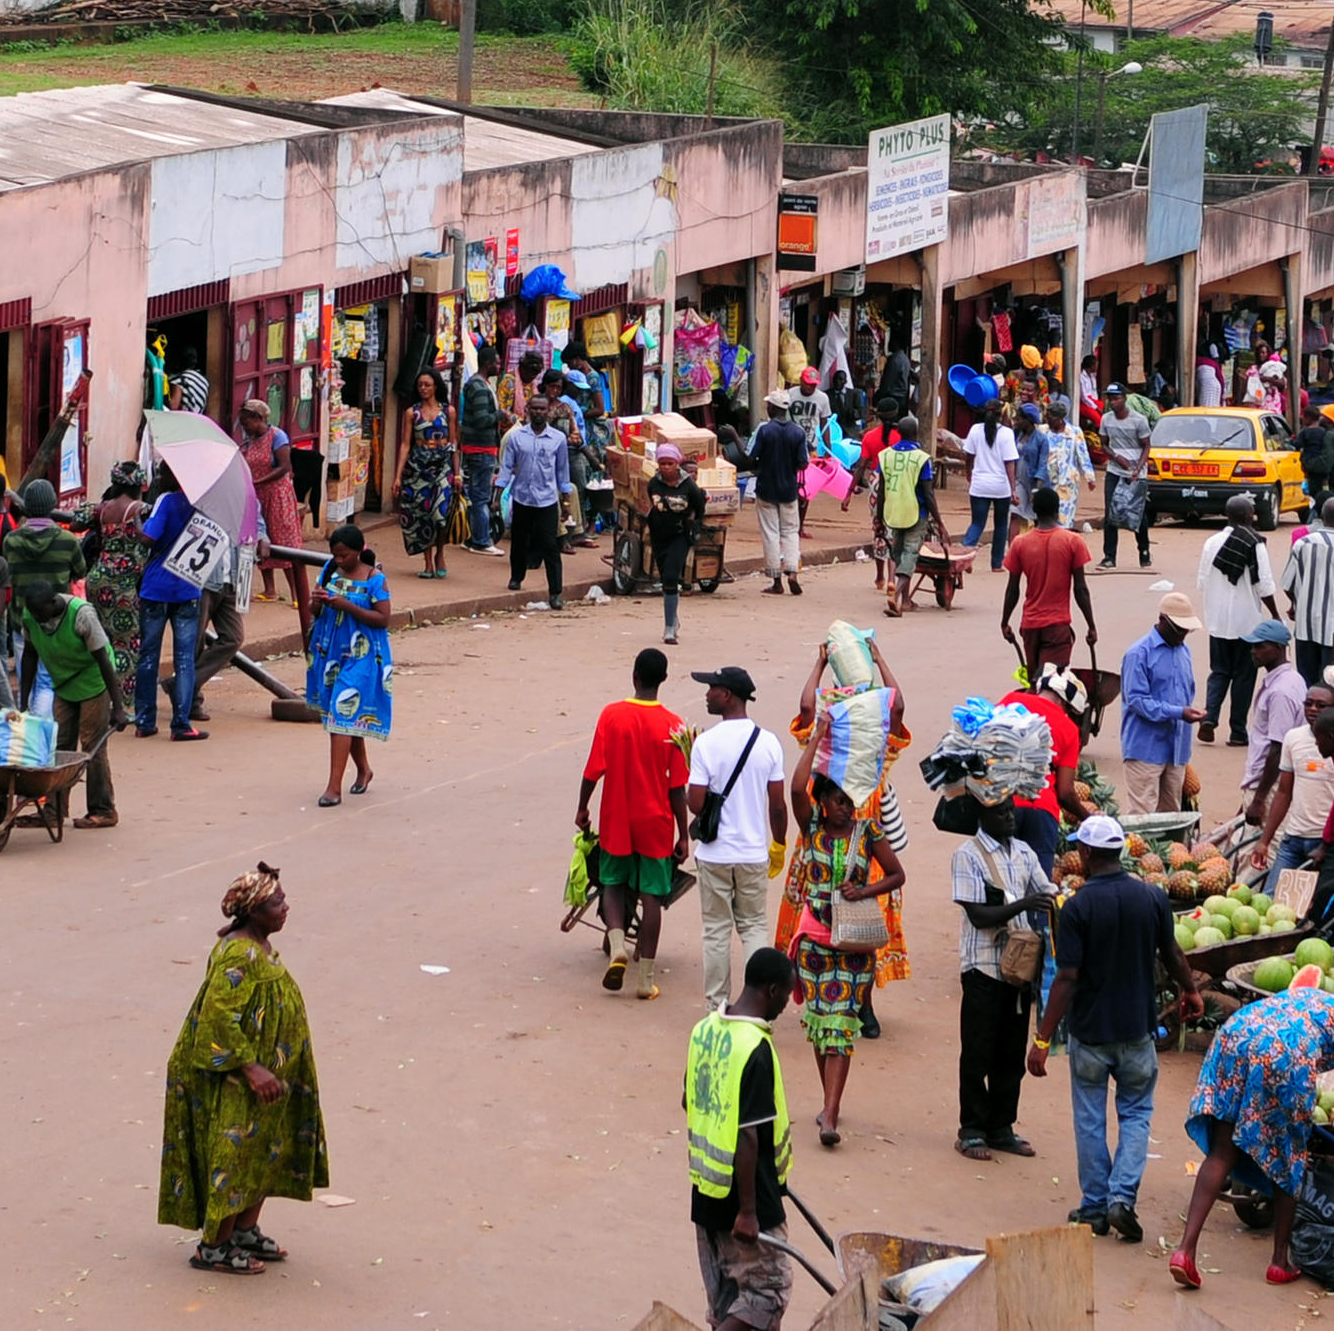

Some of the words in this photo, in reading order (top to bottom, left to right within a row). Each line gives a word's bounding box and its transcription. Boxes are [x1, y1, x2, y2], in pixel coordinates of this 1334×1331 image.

[878, 129, 913, 158] PHYTO
[919, 122, 944, 148] PLUS
[186, 523, 219, 572] 75
[192, 517, 226, 542] ORANGE
